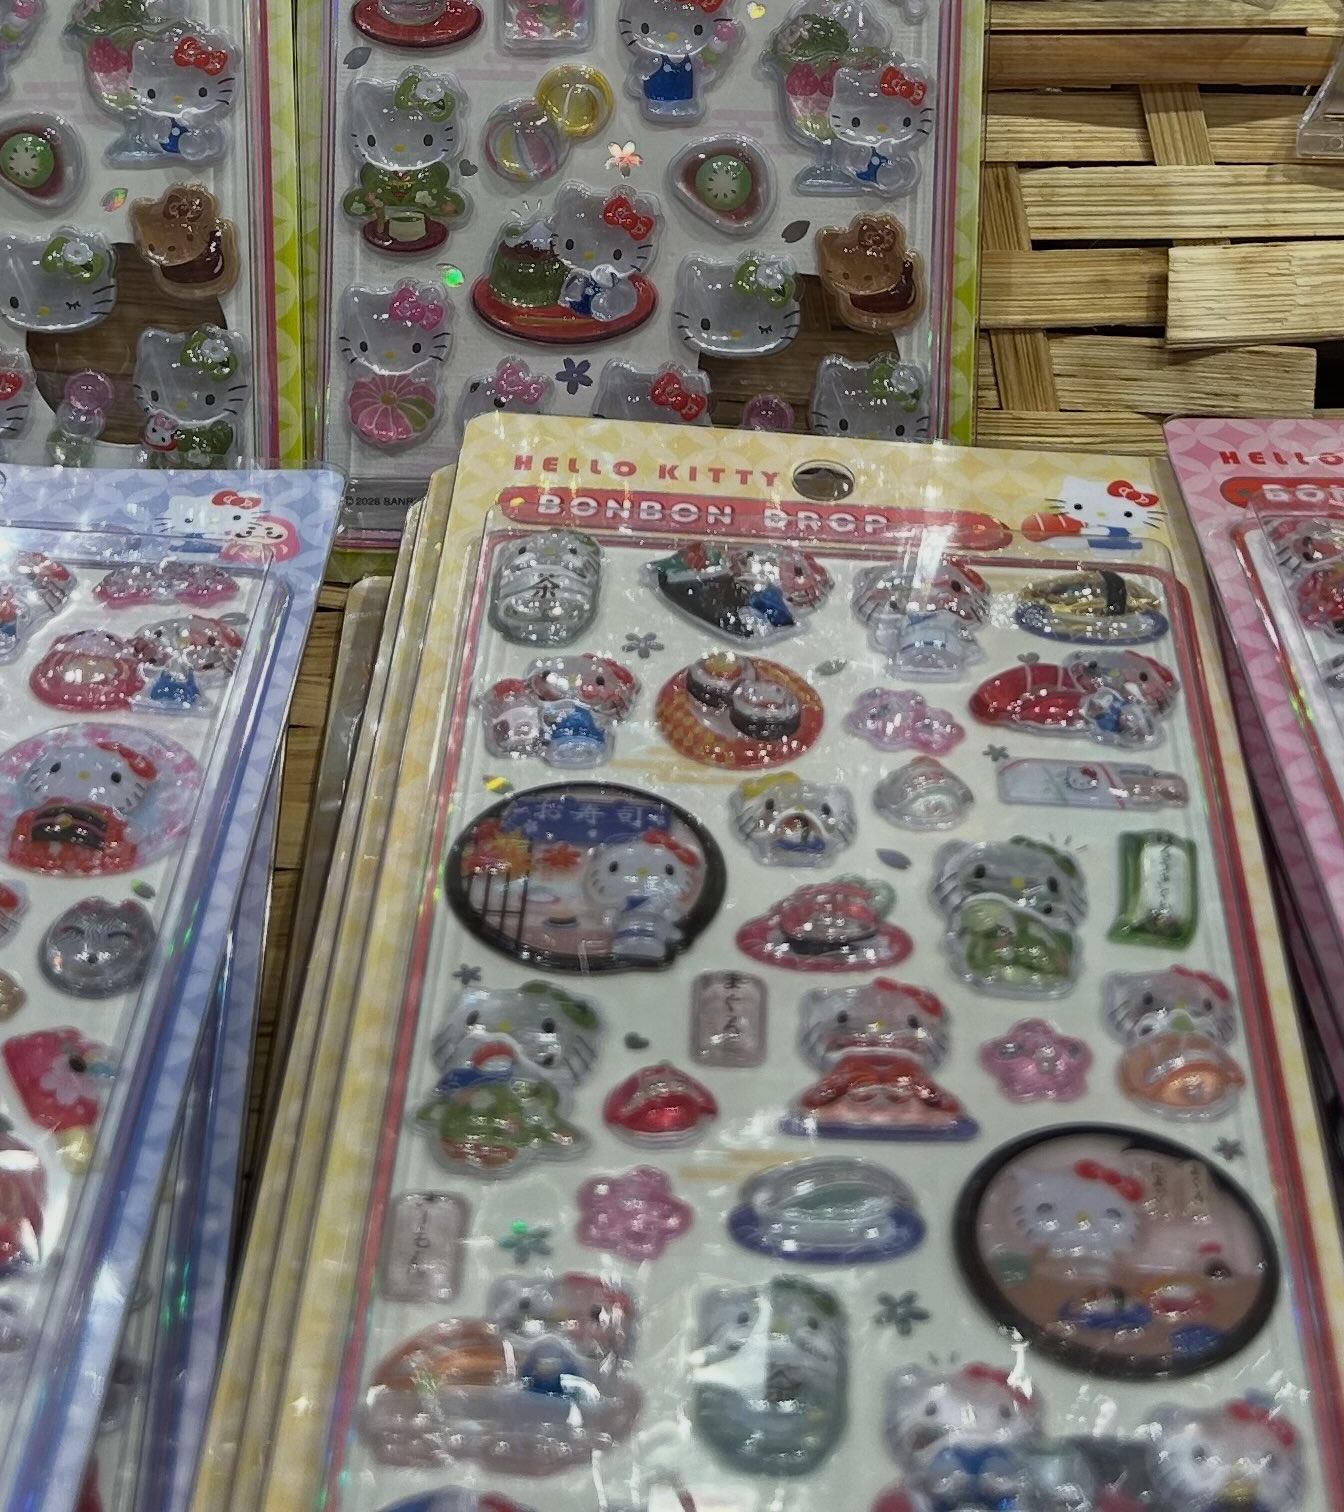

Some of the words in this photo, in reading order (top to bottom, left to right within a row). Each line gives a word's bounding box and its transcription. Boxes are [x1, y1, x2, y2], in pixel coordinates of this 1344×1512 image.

[513, 454, 638, 478] HELLO
[658, 463, 781, 488] KITTY
[1220, 450, 1344, 467] HELLO
[537, 494, 734, 526] BONBON
[764, 507, 889, 534] DROP
